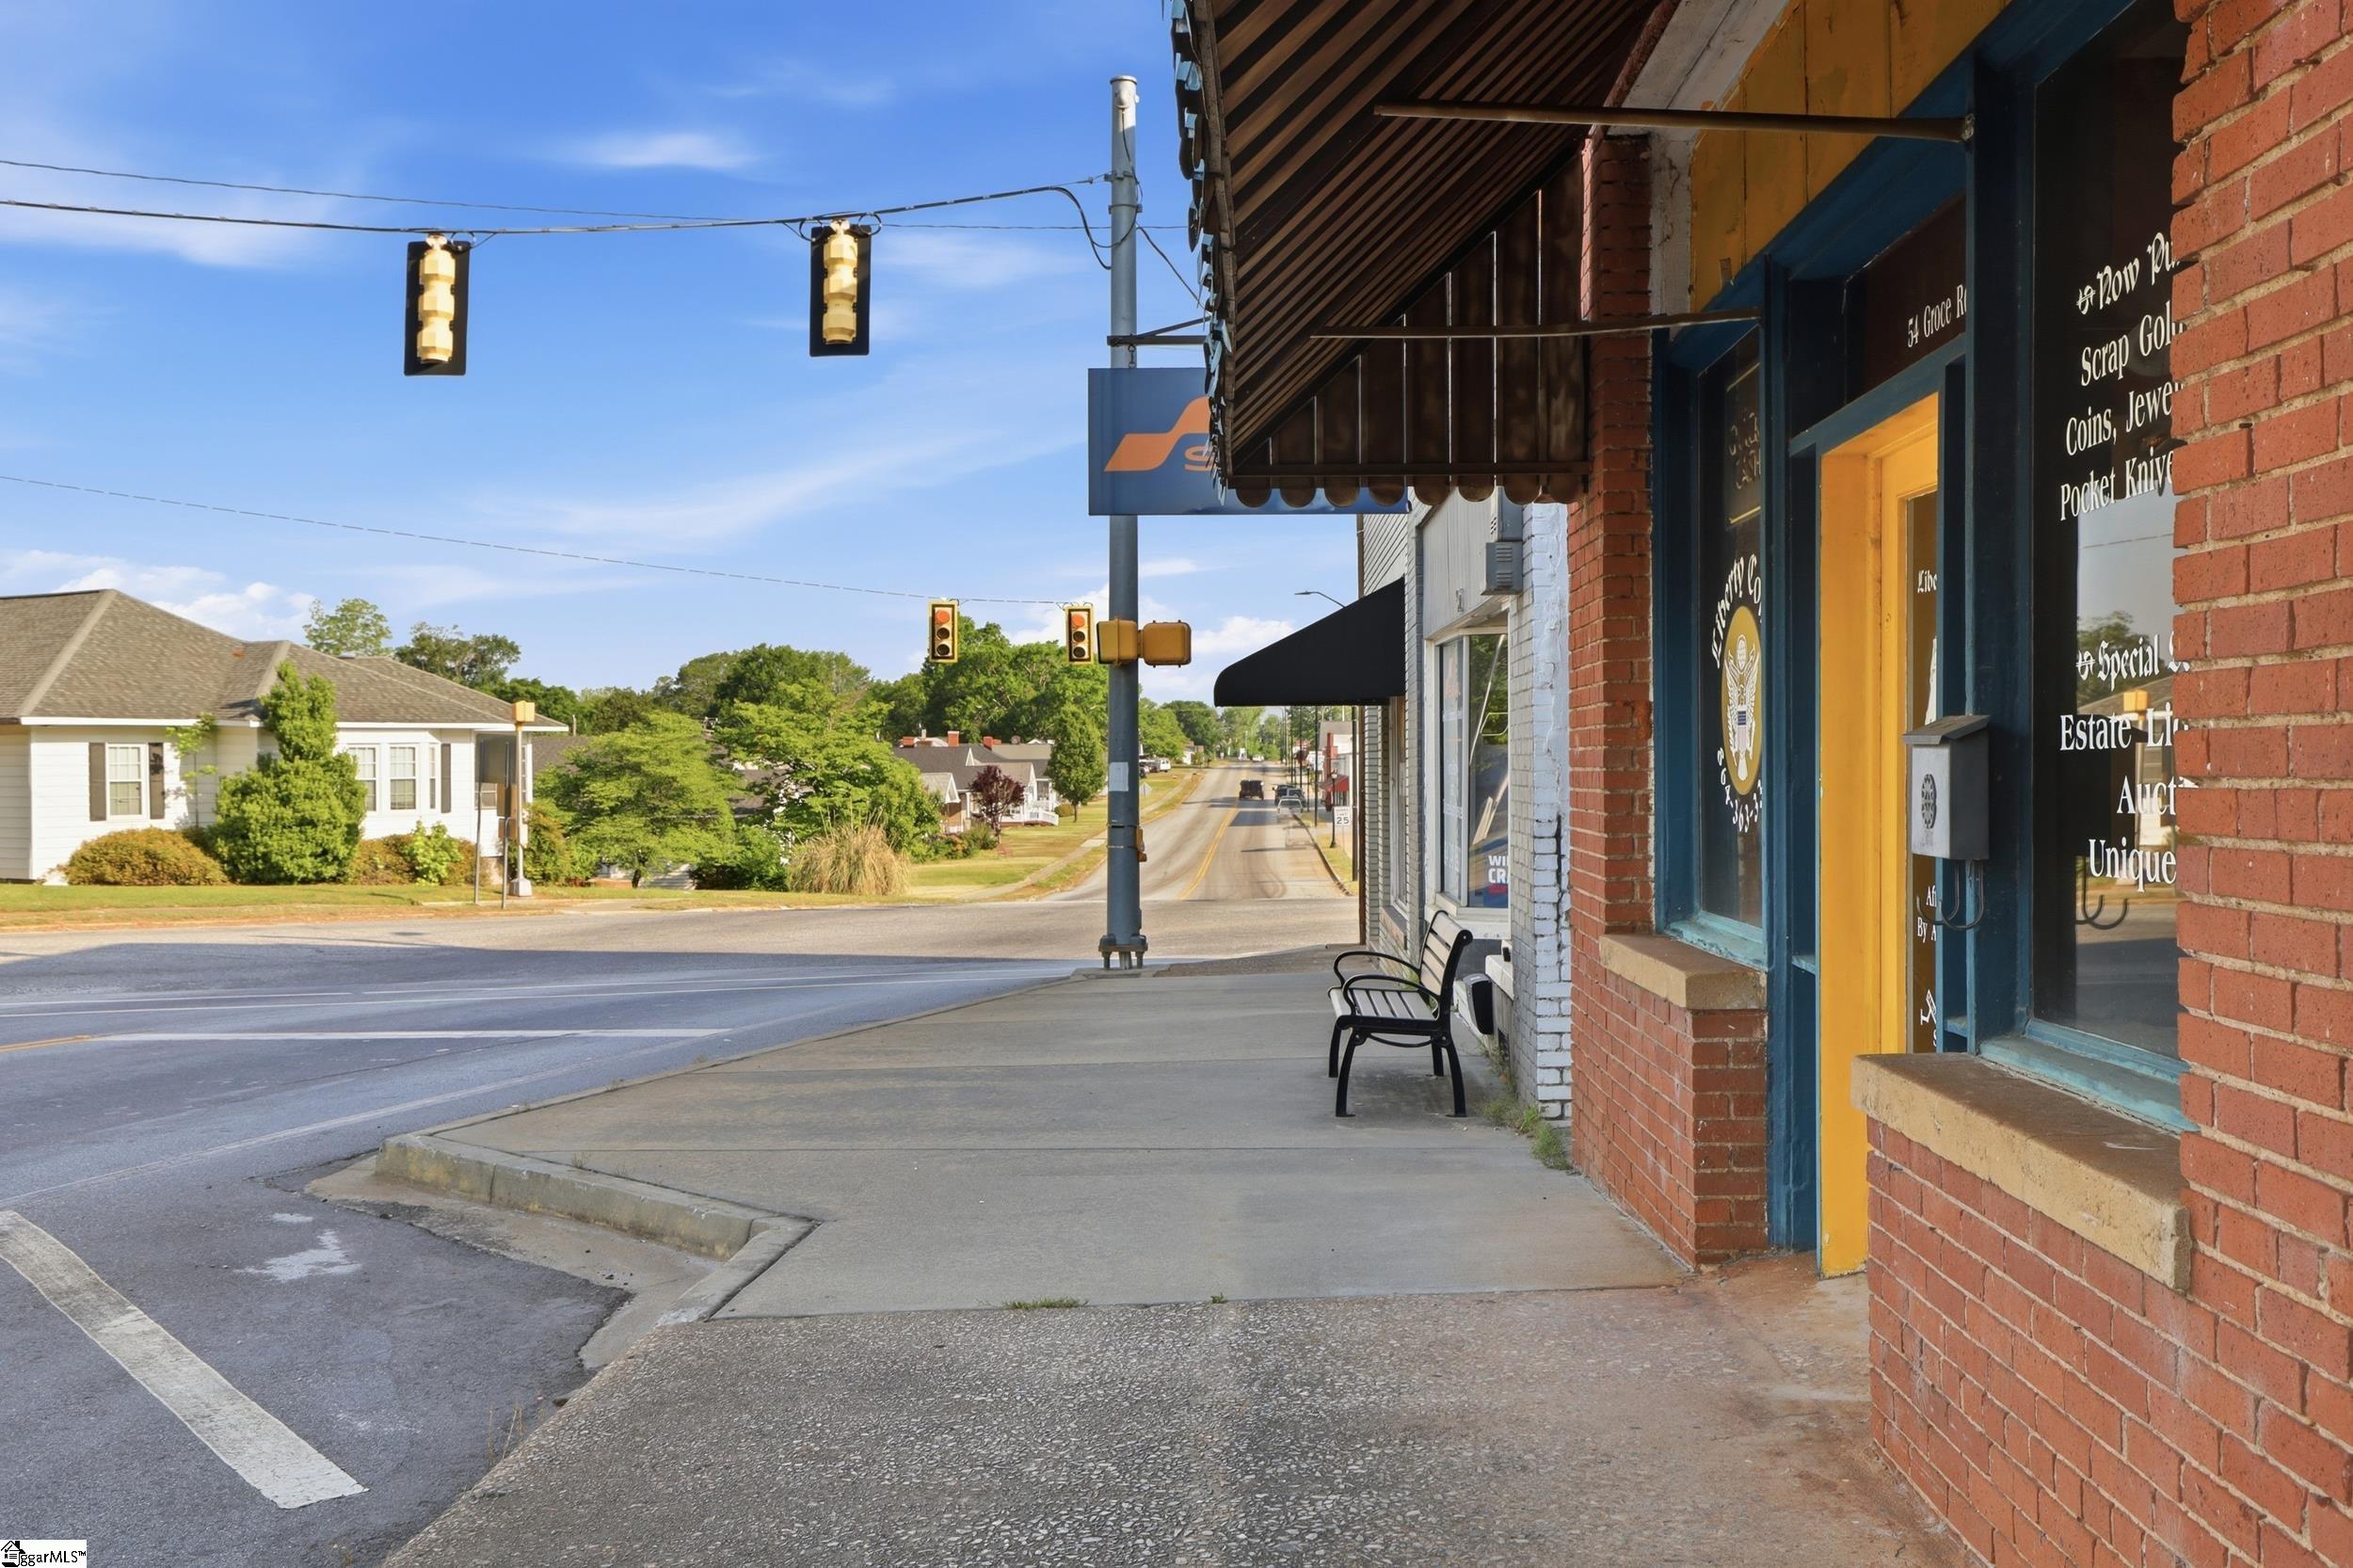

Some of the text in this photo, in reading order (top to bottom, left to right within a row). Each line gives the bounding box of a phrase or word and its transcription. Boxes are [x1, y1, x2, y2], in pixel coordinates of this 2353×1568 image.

[2096, 257, 2140, 311] Now
[1908, 313, 1919, 348] 54
[1923, 297, 1952, 338] Groce
[2081, 299, 2184, 386] Scrap Gol
[2066, 381, 2184, 456] Coins, Jewe
[2060, 467, 2116, 521] Pocket
[1711, 556, 1744, 669] Liberty
[2097, 634, 2160, 692] Special
[2060, 701, 2189, 750] Estate Li
[1337, 816, 1350, 824] 25
[2117, 775, 2177, 816] Auct
[2089, 836, 2177, 893] Unique
[1917, 917, 1929, 943] By
